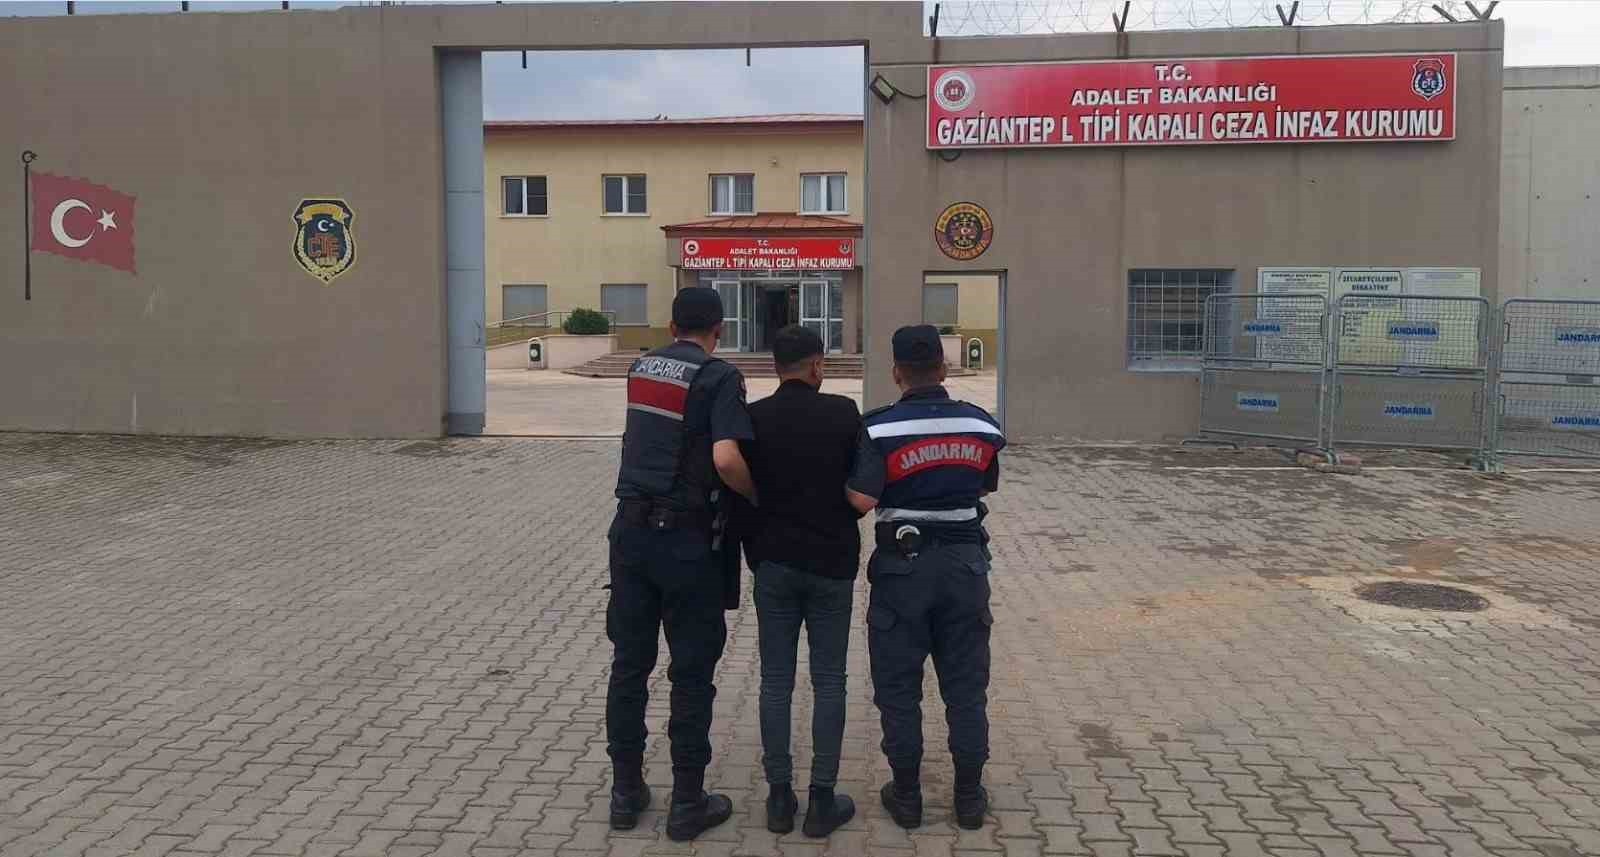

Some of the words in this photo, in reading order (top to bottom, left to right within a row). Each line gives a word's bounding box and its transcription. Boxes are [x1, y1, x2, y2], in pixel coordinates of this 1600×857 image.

[1154, 64, 1192, 81] T.C.
[1071, 89, 1152, 106] ADALET
[1159, 82, 1277, 104] BAKANLIĞI
[936, 112, 1056, 145] GAZİANTEP
[1062, 116, 1073, 142] L
[1080, 109, 1121, 142] TİPİ
[1127, 113, 1204, 142] KAPALI
[1210, 112, 1268, 139] CEZA
[1275, 105, 1339, 138] İNFAZ
[1345, 109, 1444, 137] KURUMU
[729, 247, 757, 255] ADALET
[759, 246, 798, 255] BAKANLIĞI
[684, 256, 725, 268] GAZİANTEP
[726, 257, 732, 268] L
[733, 255, 747, 268] TİPİ
[749, 256, 775, 268] KAPALI
[776, 256, 796, 268] CEZA
[797, 254, 819, 268] İNFAZ
[820, 256, 853, 268] KURUMU
[1390, 326, 1438, 337] JANDARMA
[634, 358, 687, 380] JANDARMA
[1384, 405, 1433, 417] JANDARMA
[901, 443, 982, 469] JANDARMA
